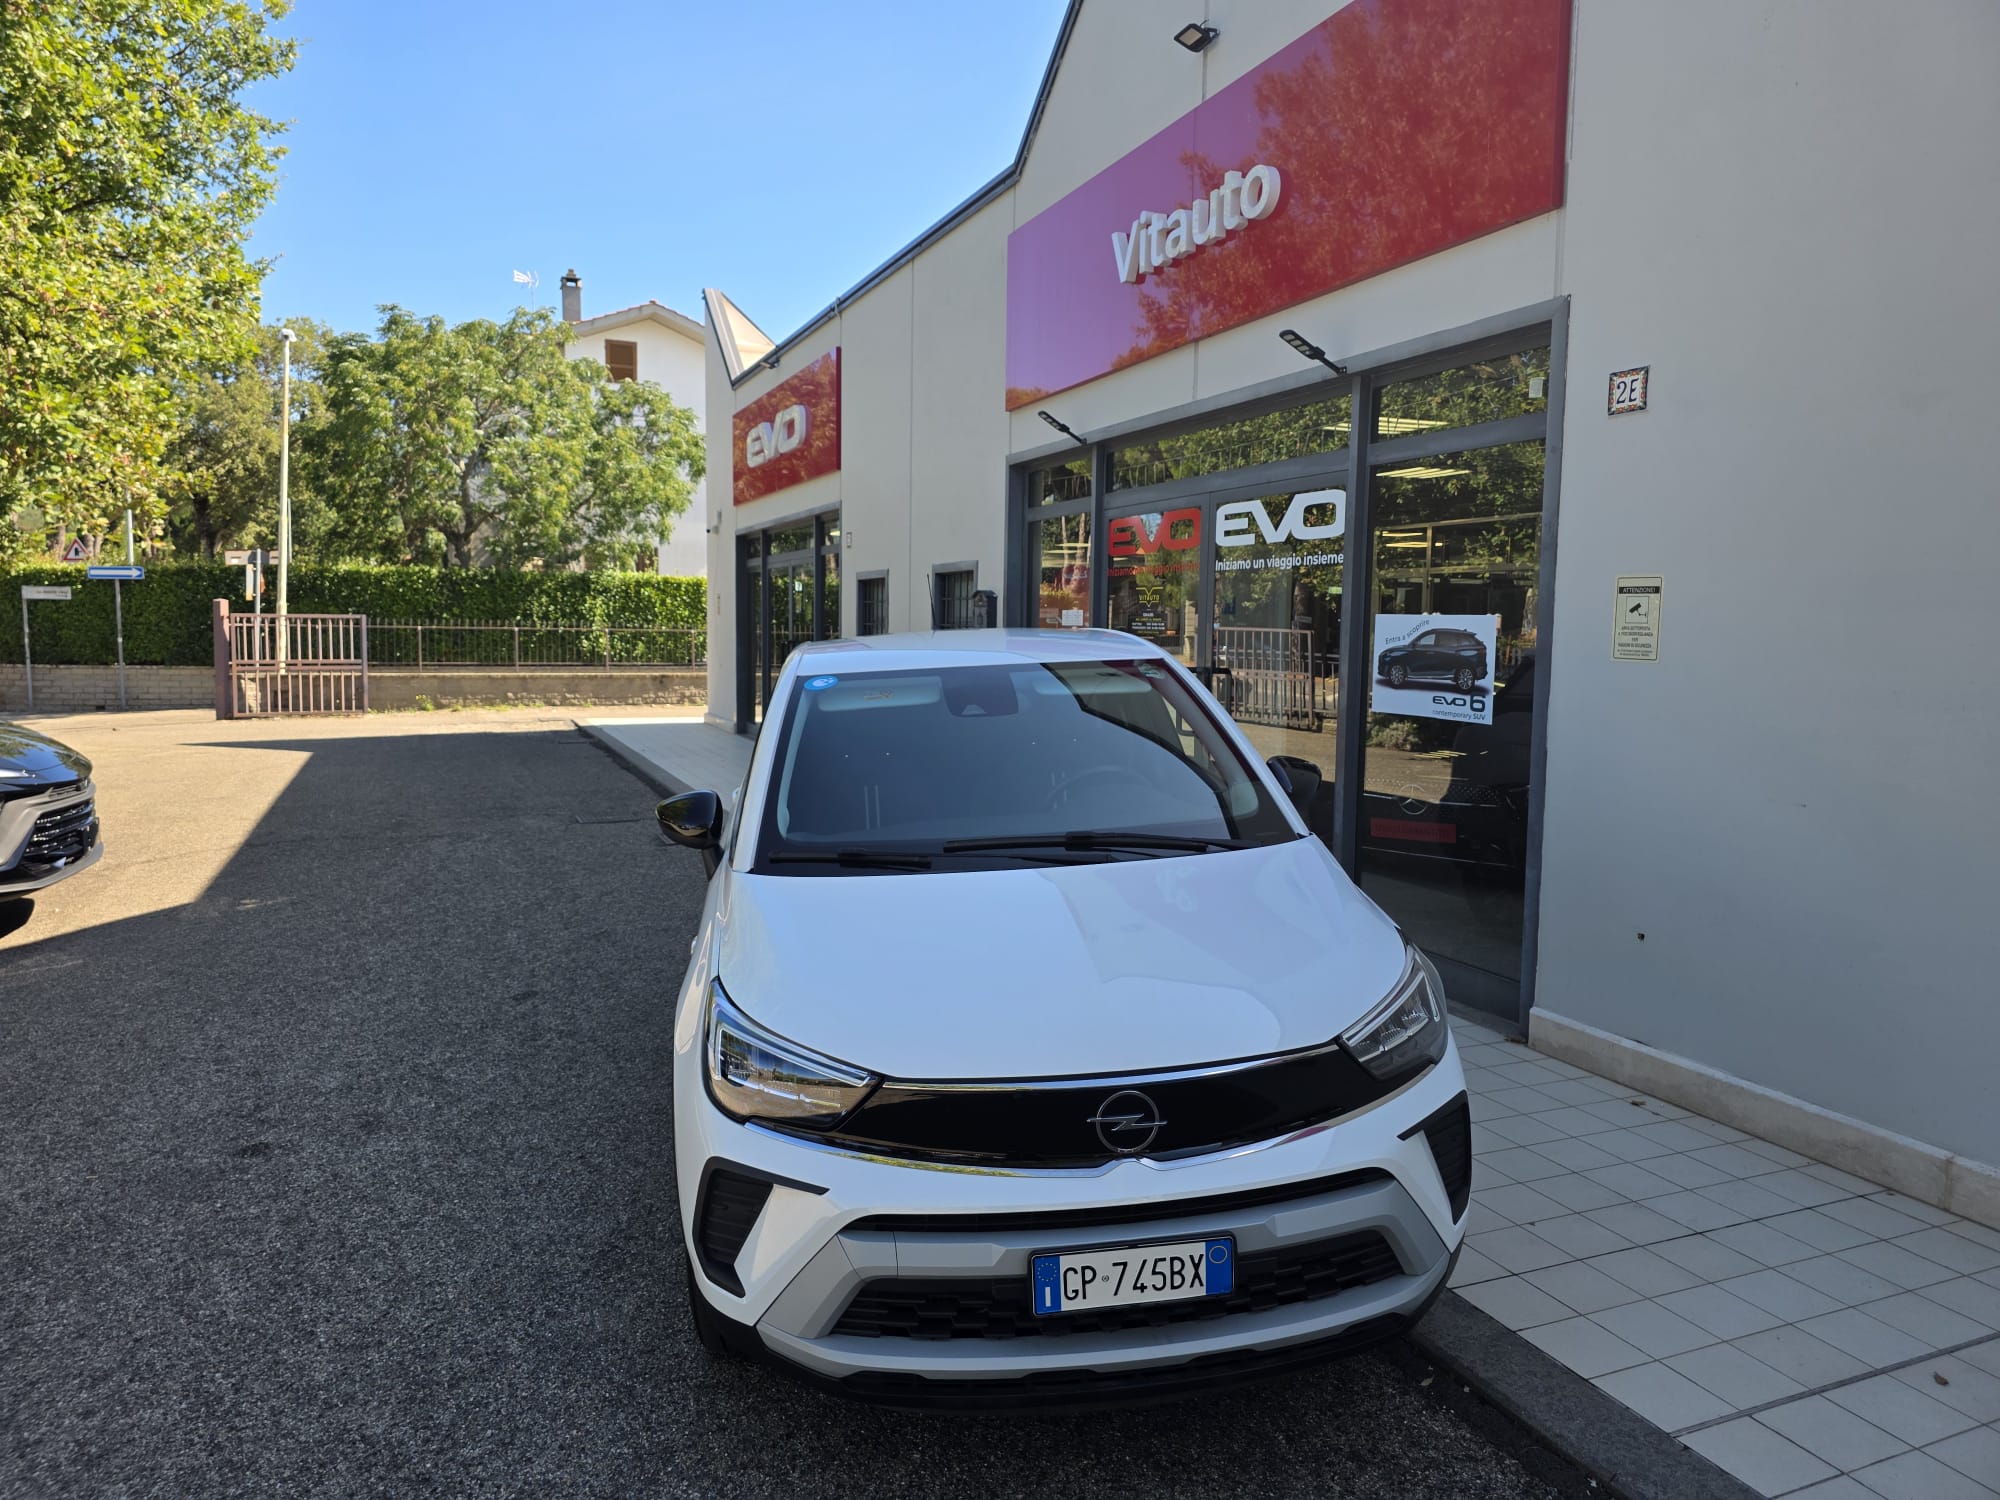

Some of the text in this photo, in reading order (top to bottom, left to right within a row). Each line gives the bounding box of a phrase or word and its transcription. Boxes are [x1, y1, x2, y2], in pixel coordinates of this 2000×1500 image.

[1112, 164, 1281, 284] Vitauto
[1616, 376, 1640, 405] 2E
[747, 405, 807, 468] EVO
[1108, 507, 1202, 557] EVO
[1216, 489, 1346, 547] EVO
[1215, 551, 1344, 571] Iniziamo un viaggio insieme
[1432, 695, 1486, 713] EVO 6
[1473, 712, 1486, 721] SUV
